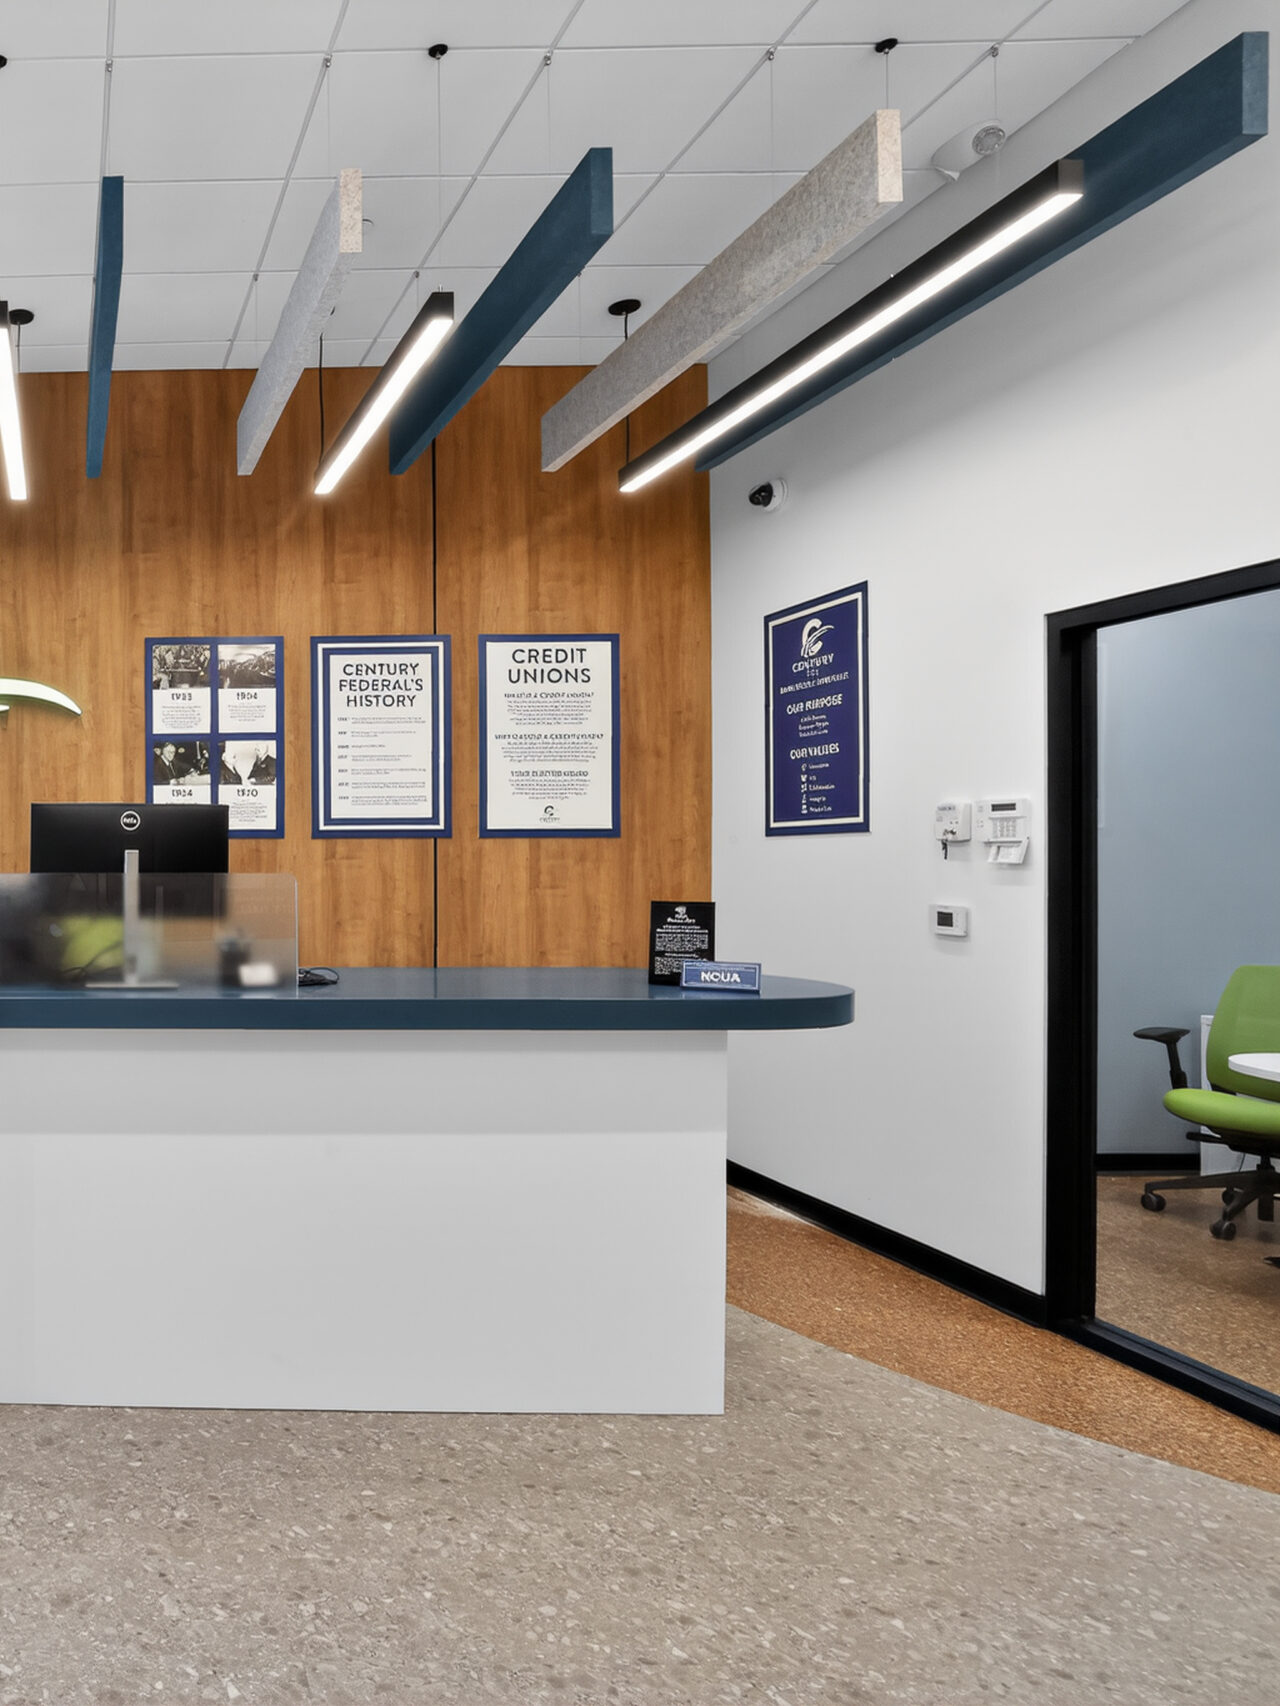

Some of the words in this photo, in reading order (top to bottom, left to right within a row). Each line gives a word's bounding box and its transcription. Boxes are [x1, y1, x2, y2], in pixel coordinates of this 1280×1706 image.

[512, 648, 587, 664] CREDIT
[342, 663, 420, 676] CENTURY
[508, 668, 591, 684] UNIONS
[338, 679, 424, 692] FEDERAL'S
[346, 694, 417, 708] HISTORY
